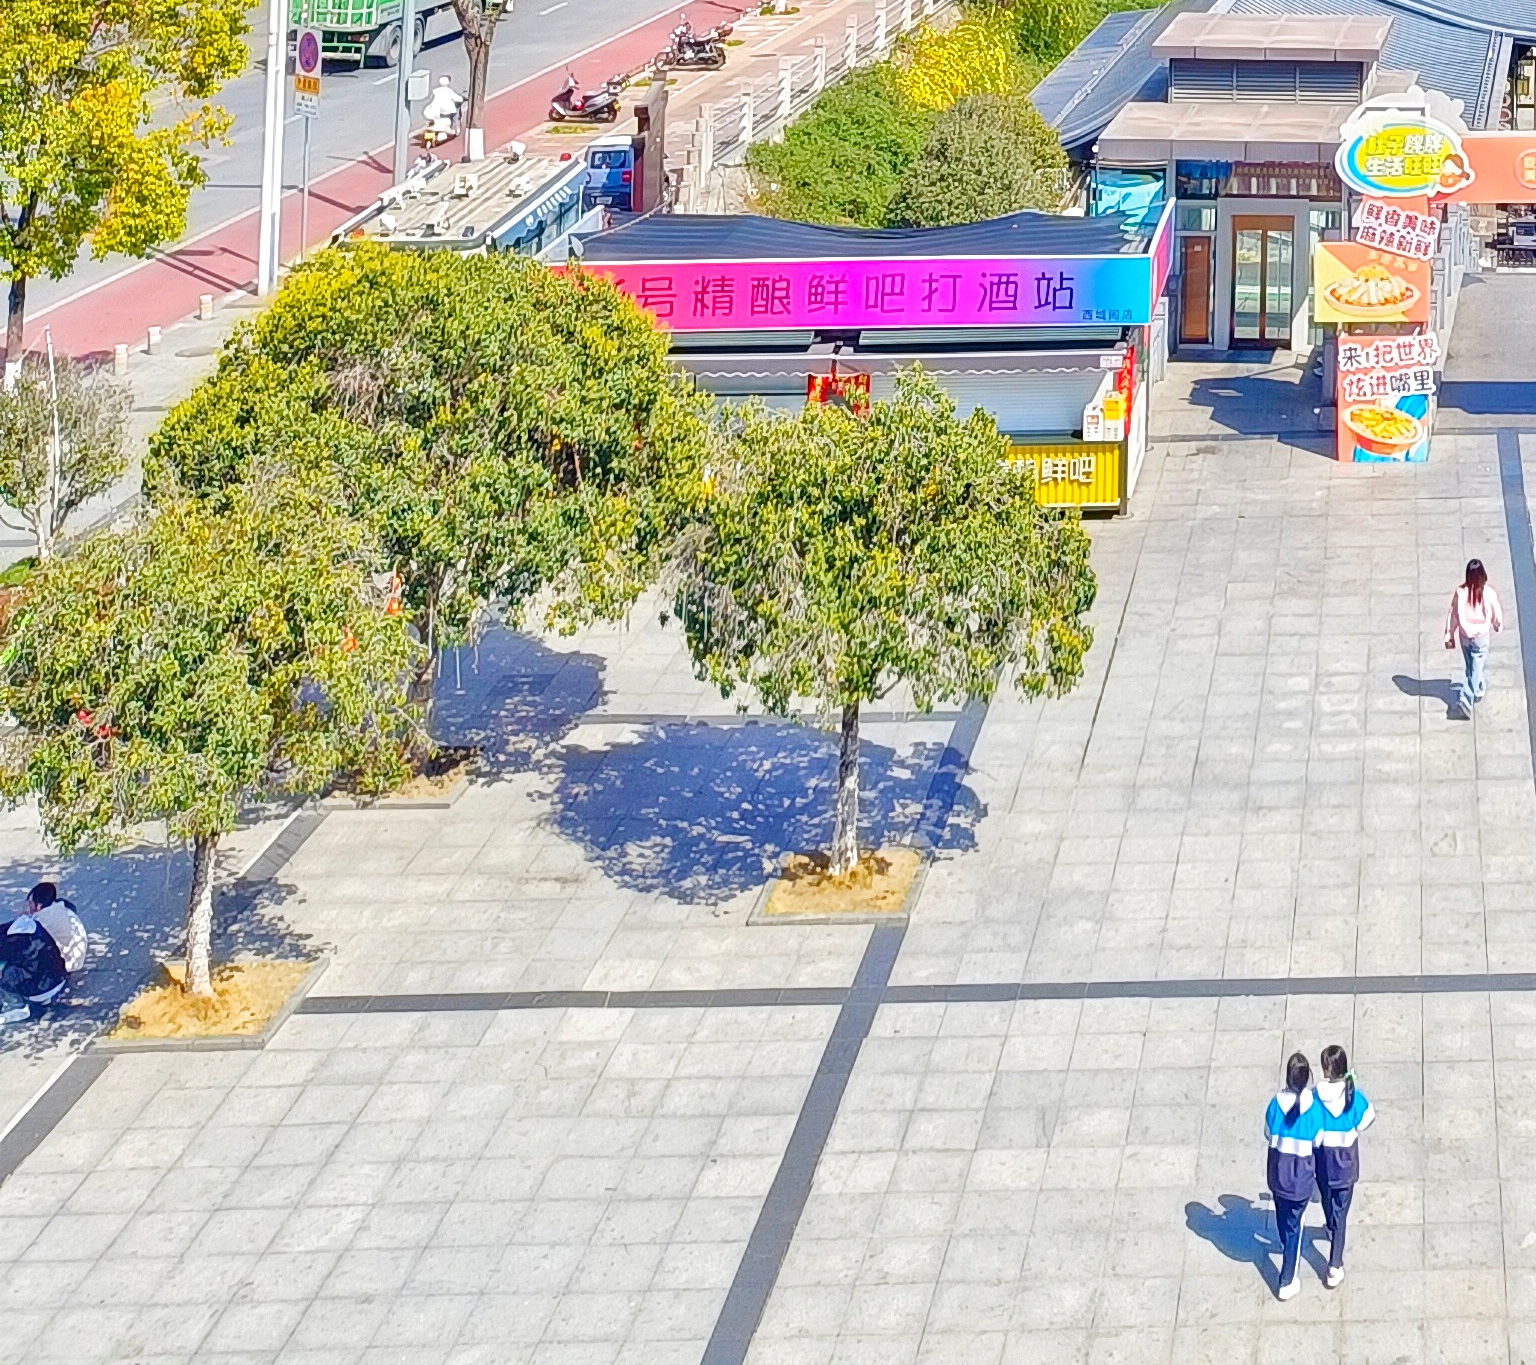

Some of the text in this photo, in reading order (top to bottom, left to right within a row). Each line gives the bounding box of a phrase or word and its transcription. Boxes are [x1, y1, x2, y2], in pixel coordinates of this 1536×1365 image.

[613, 271, 1074, 317] 号精酿鲜吧打酒站
